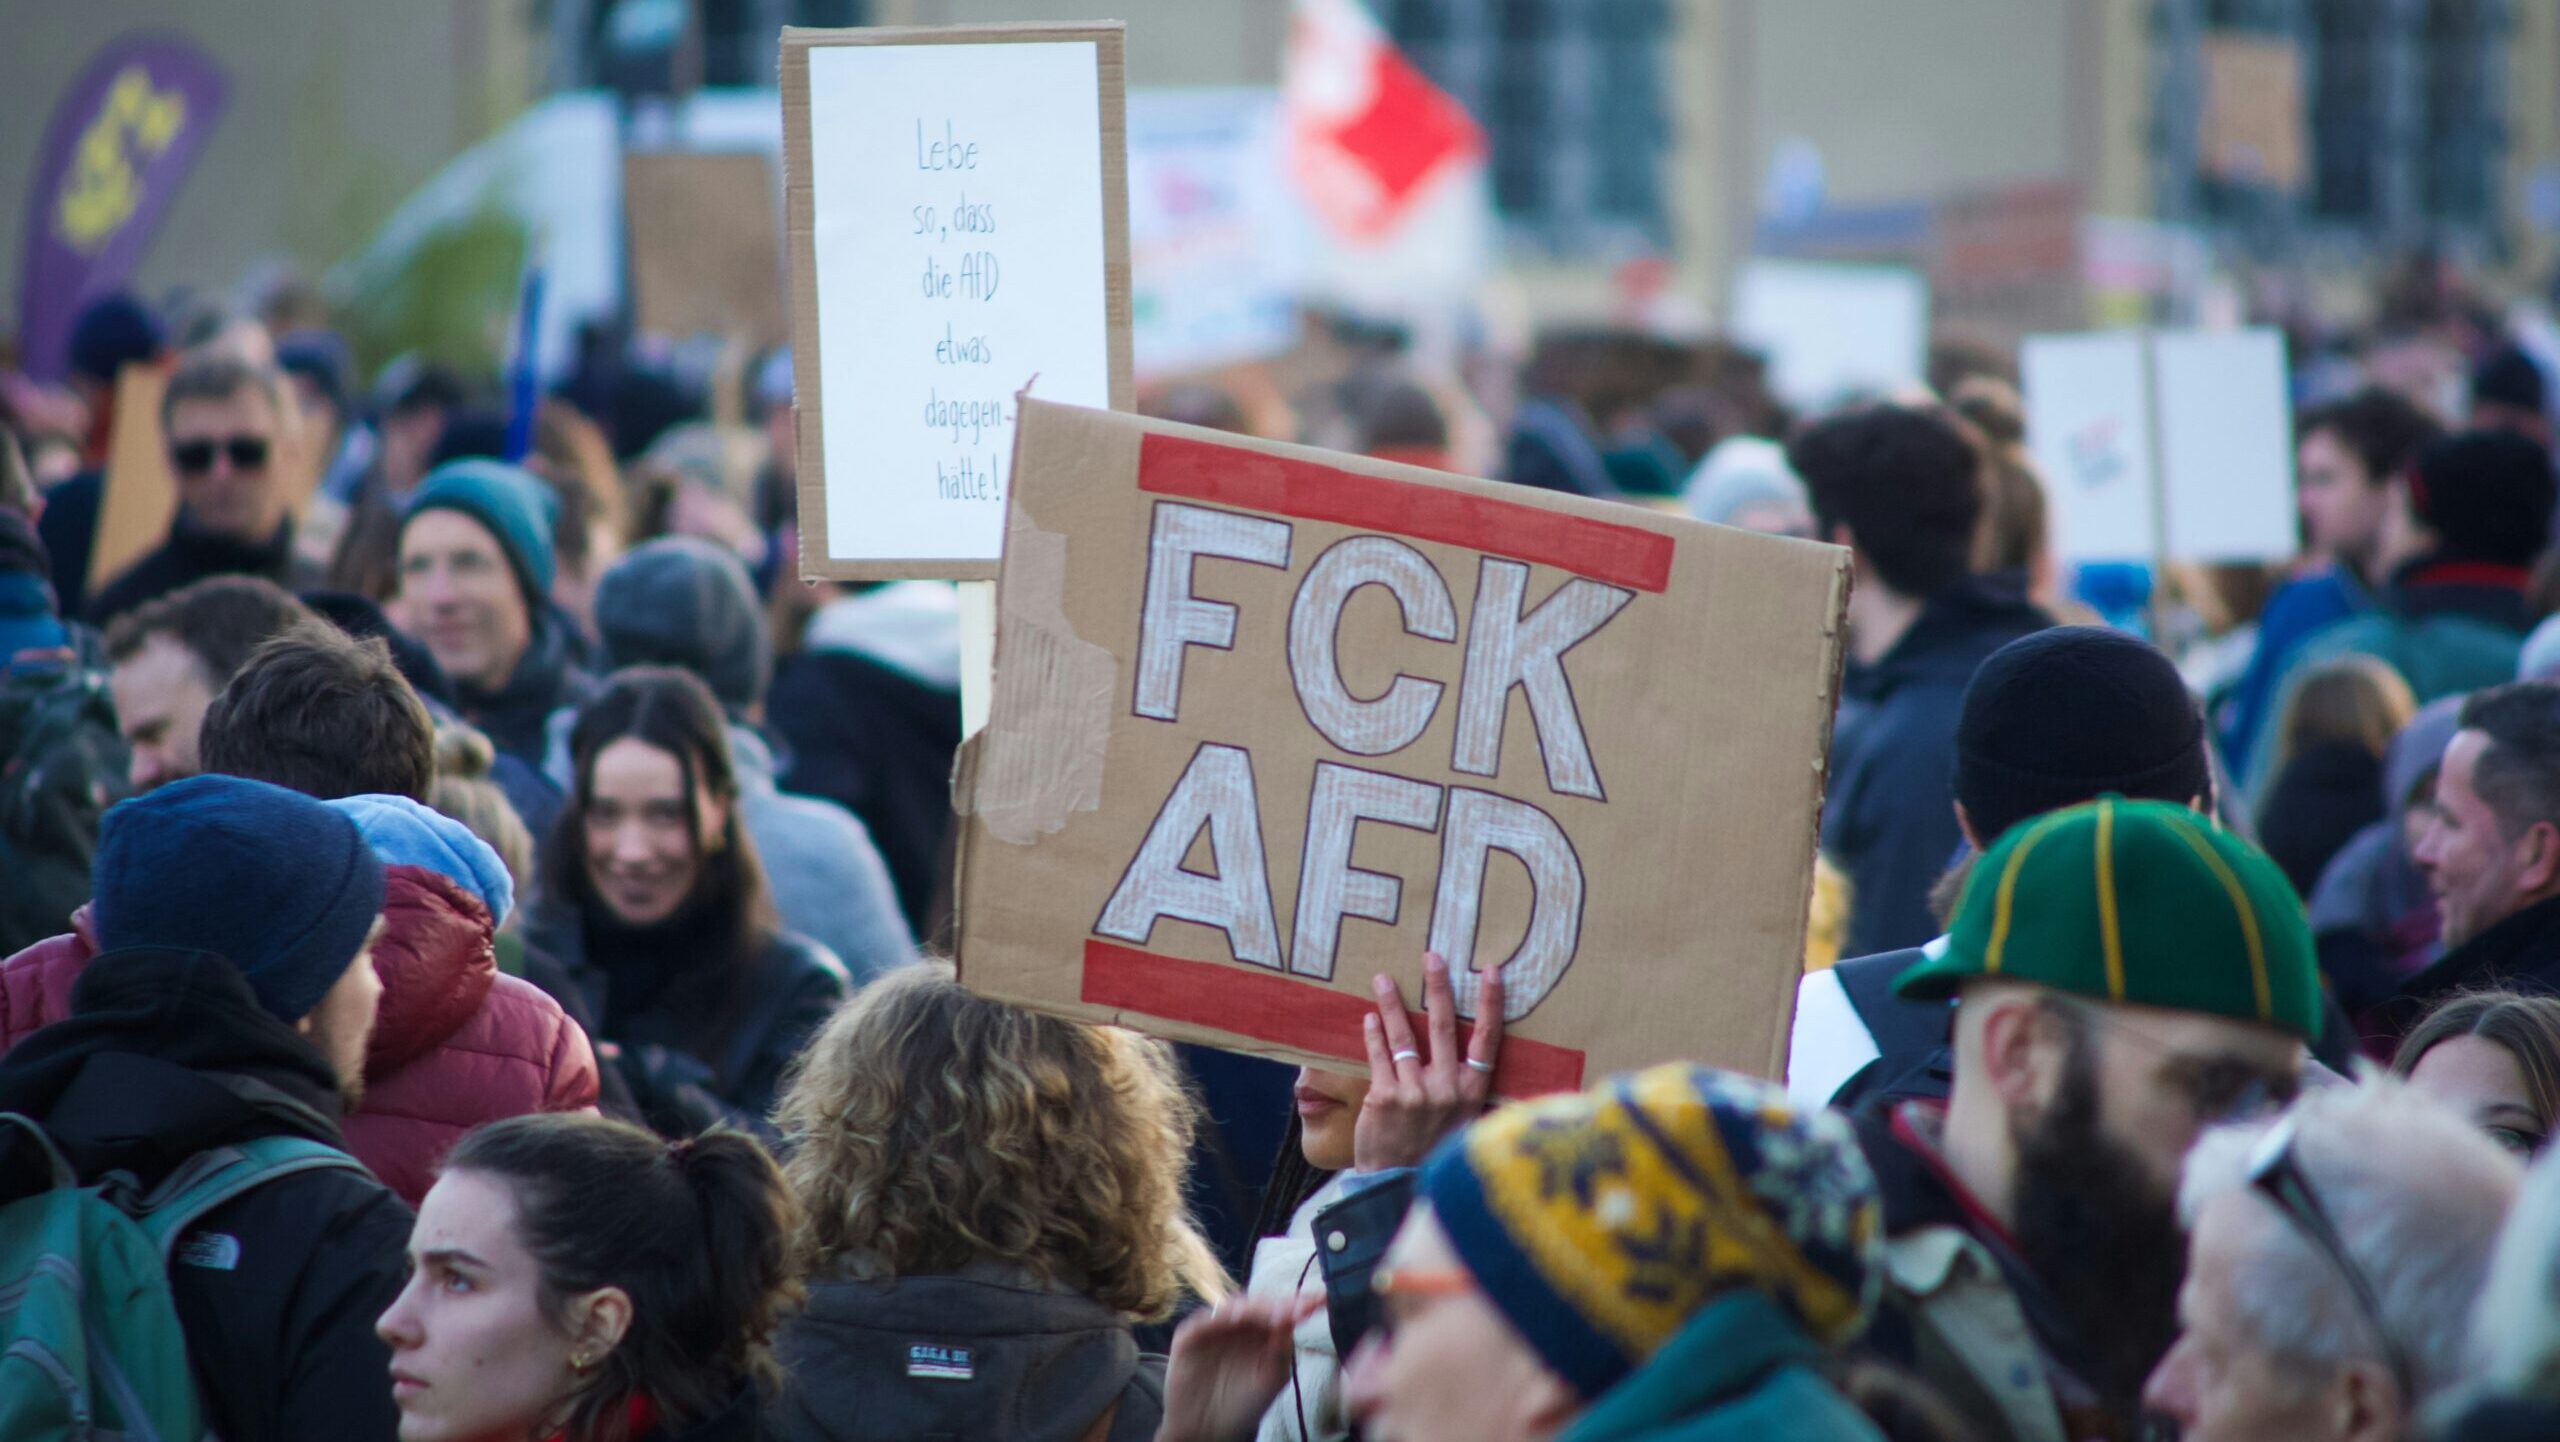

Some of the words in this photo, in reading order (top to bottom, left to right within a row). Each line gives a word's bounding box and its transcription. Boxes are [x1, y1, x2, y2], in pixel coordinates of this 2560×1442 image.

[916, 117, 979, 171] Lebe
[912, 205, 946, 243] so,
[953, 191, 995, 233] dass
[922, 255, 952, 299] die
[959, 251, 999, 302] AfD
[936, 321, 991, 364] etwas
[925, 387, 1001, 445] dagegen
[937, 453, 1000, 501] hätte!
[1132, 499, 1637, 803] FCK
[1092, 740, 1586, 1024] AFD
